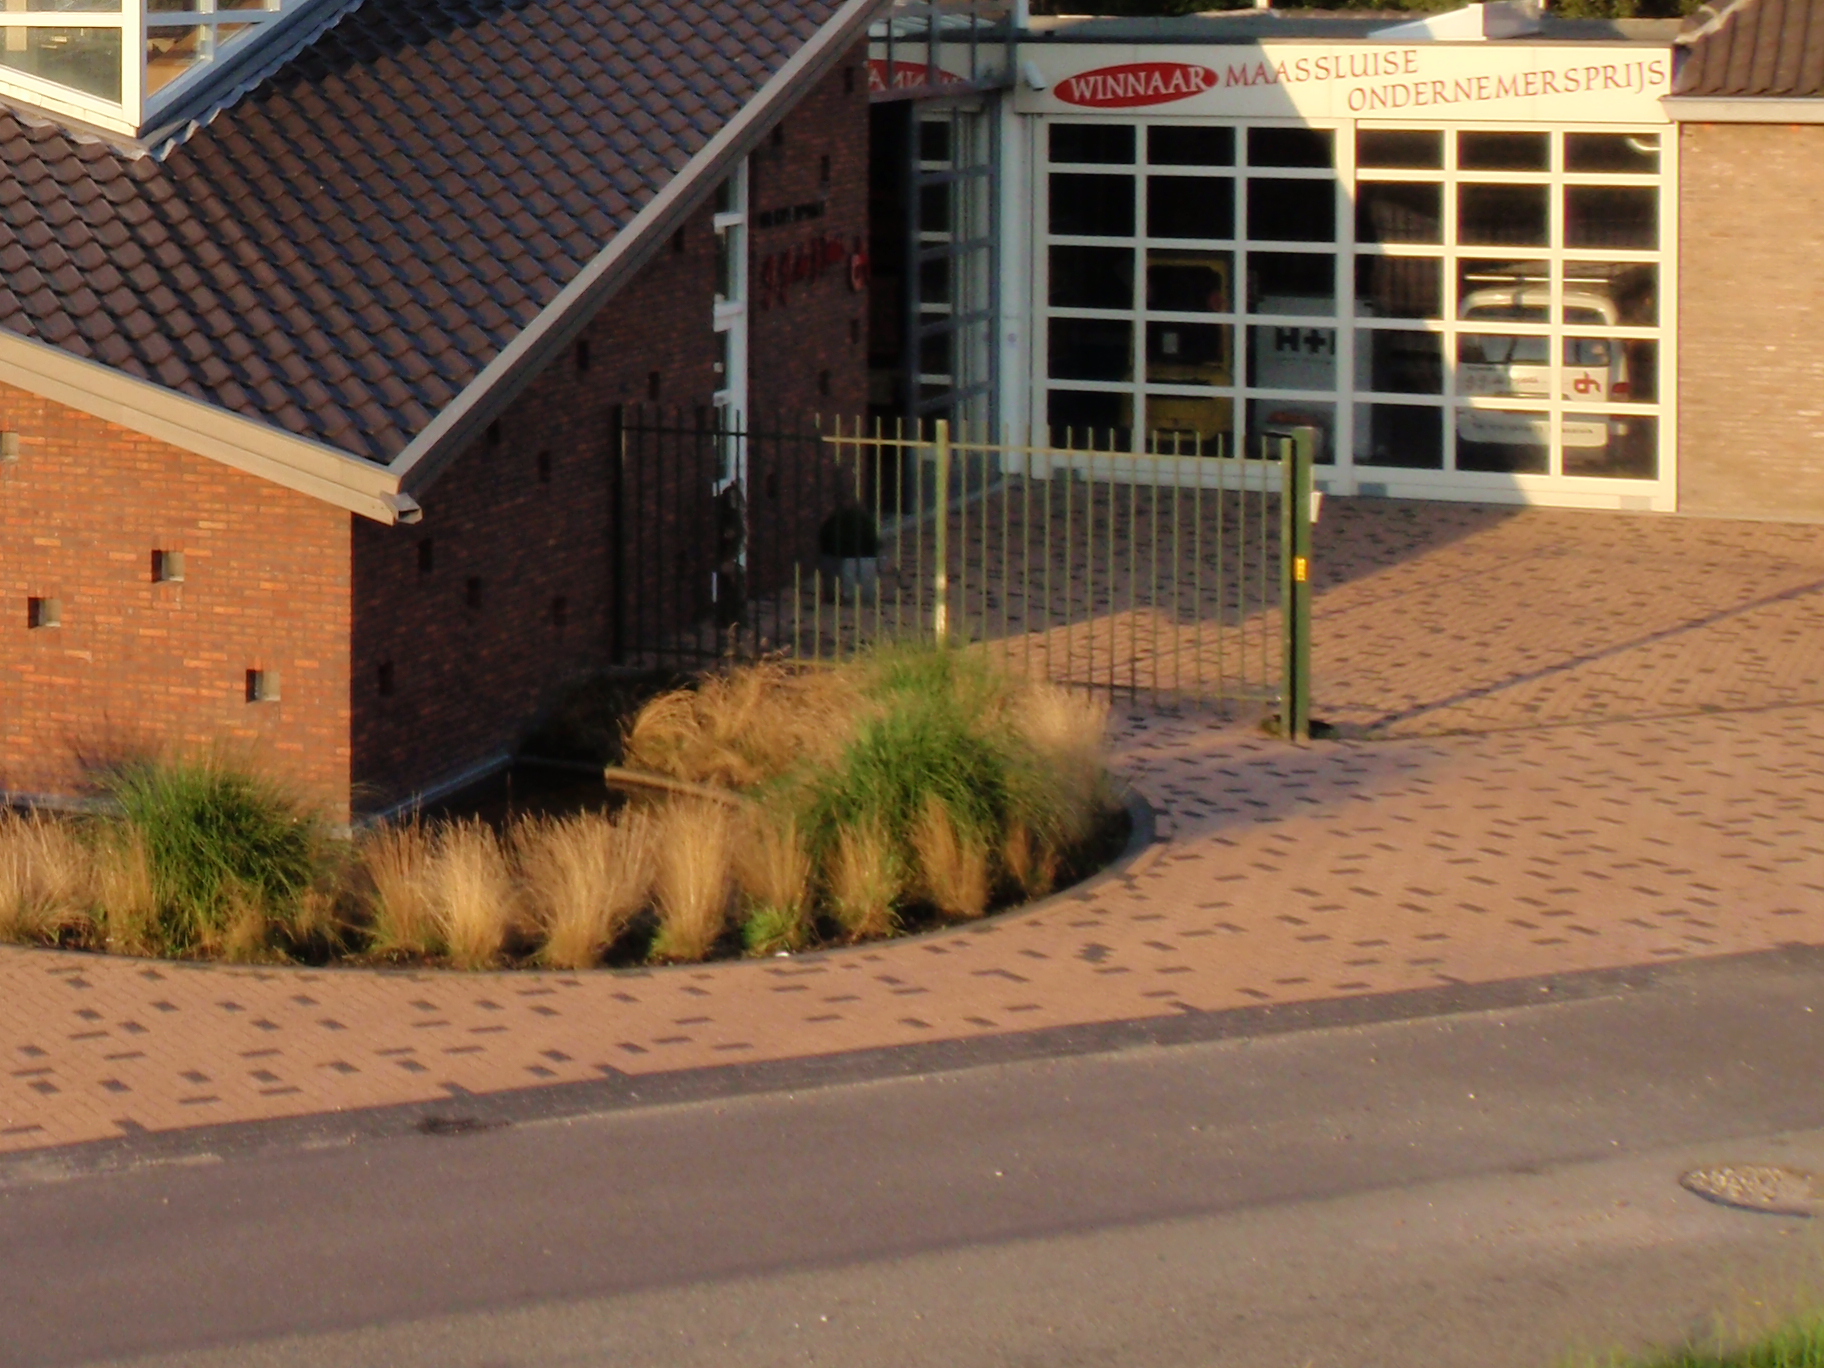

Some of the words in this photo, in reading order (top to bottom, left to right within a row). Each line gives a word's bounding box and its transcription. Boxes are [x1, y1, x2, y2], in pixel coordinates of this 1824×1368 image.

[1066, 64, 1208, 100] WINNAAR
[1226, 49, 1419, 87] MAASSLUISE
[1347, 58, 1666, 112] ONDERNEMERSPRIJS
